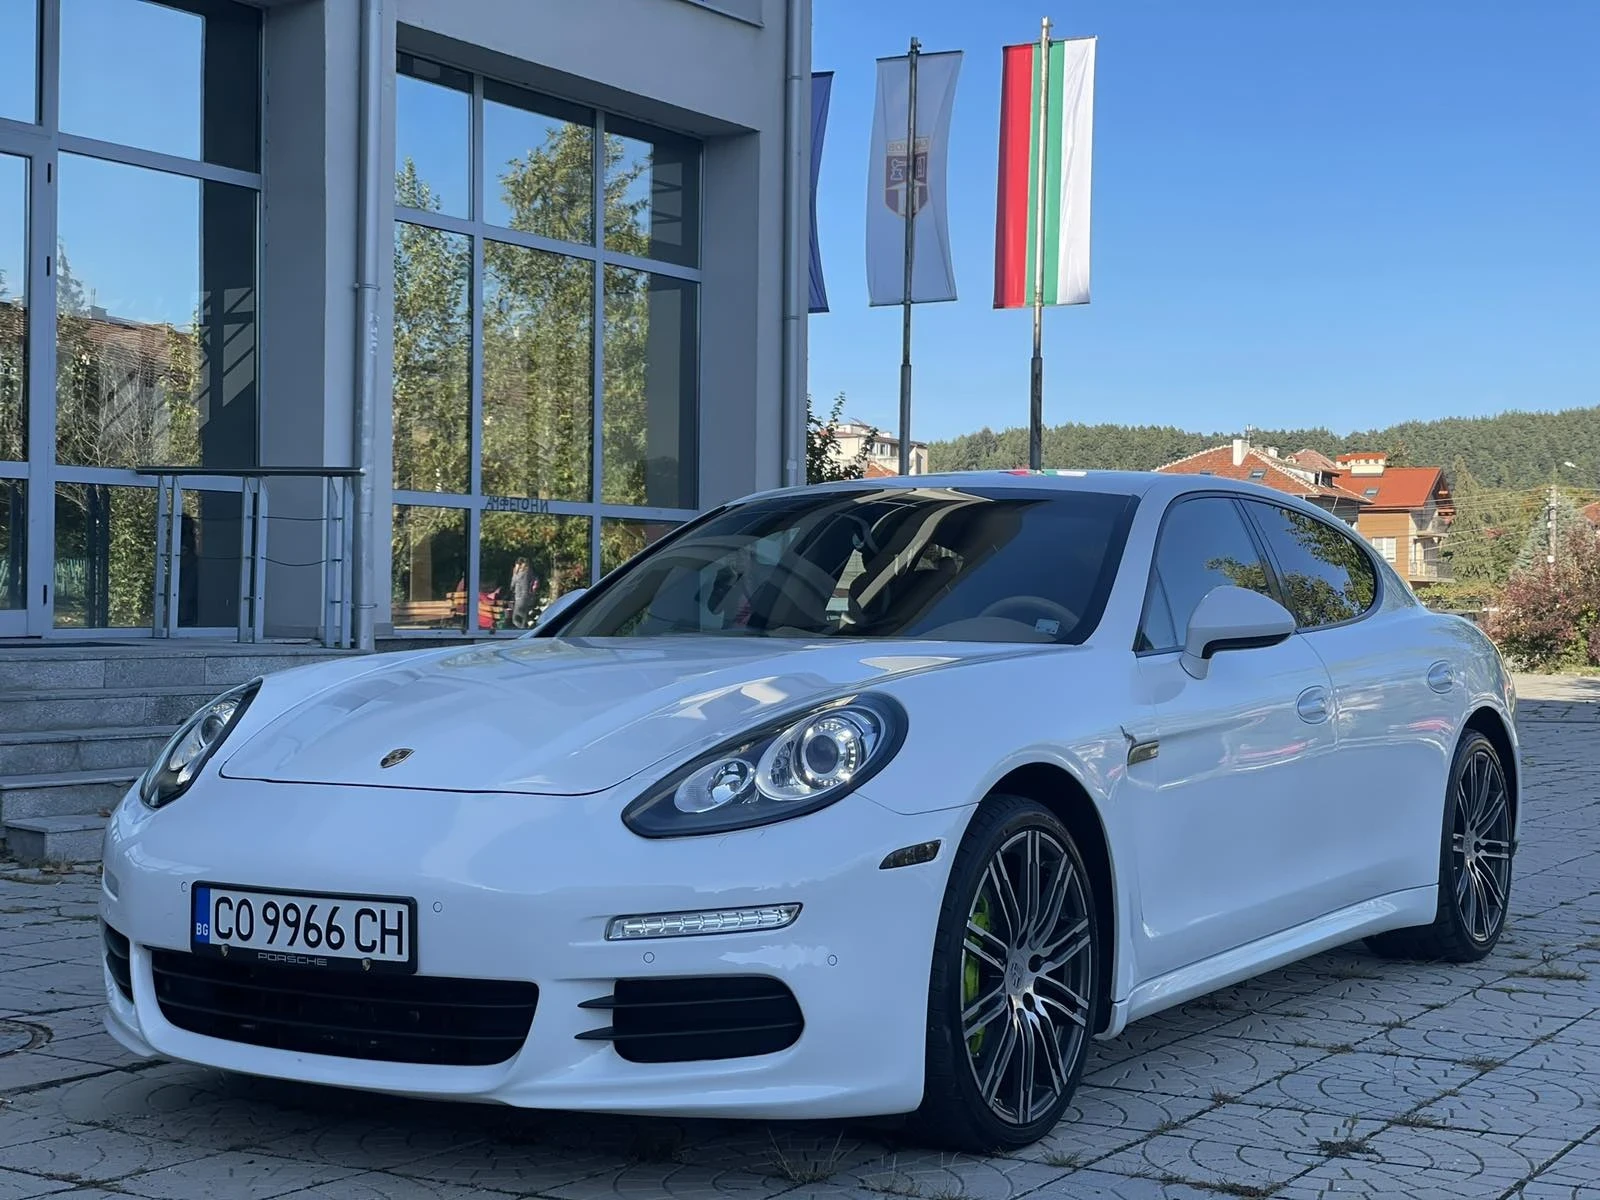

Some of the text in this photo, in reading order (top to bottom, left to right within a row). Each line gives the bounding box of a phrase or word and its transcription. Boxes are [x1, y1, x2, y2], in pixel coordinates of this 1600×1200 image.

[196, 922, 209, 936] BG
[214, 896, 404, 955] CO 9966 CH
[257, 952, 328, 967] PORSCHE
